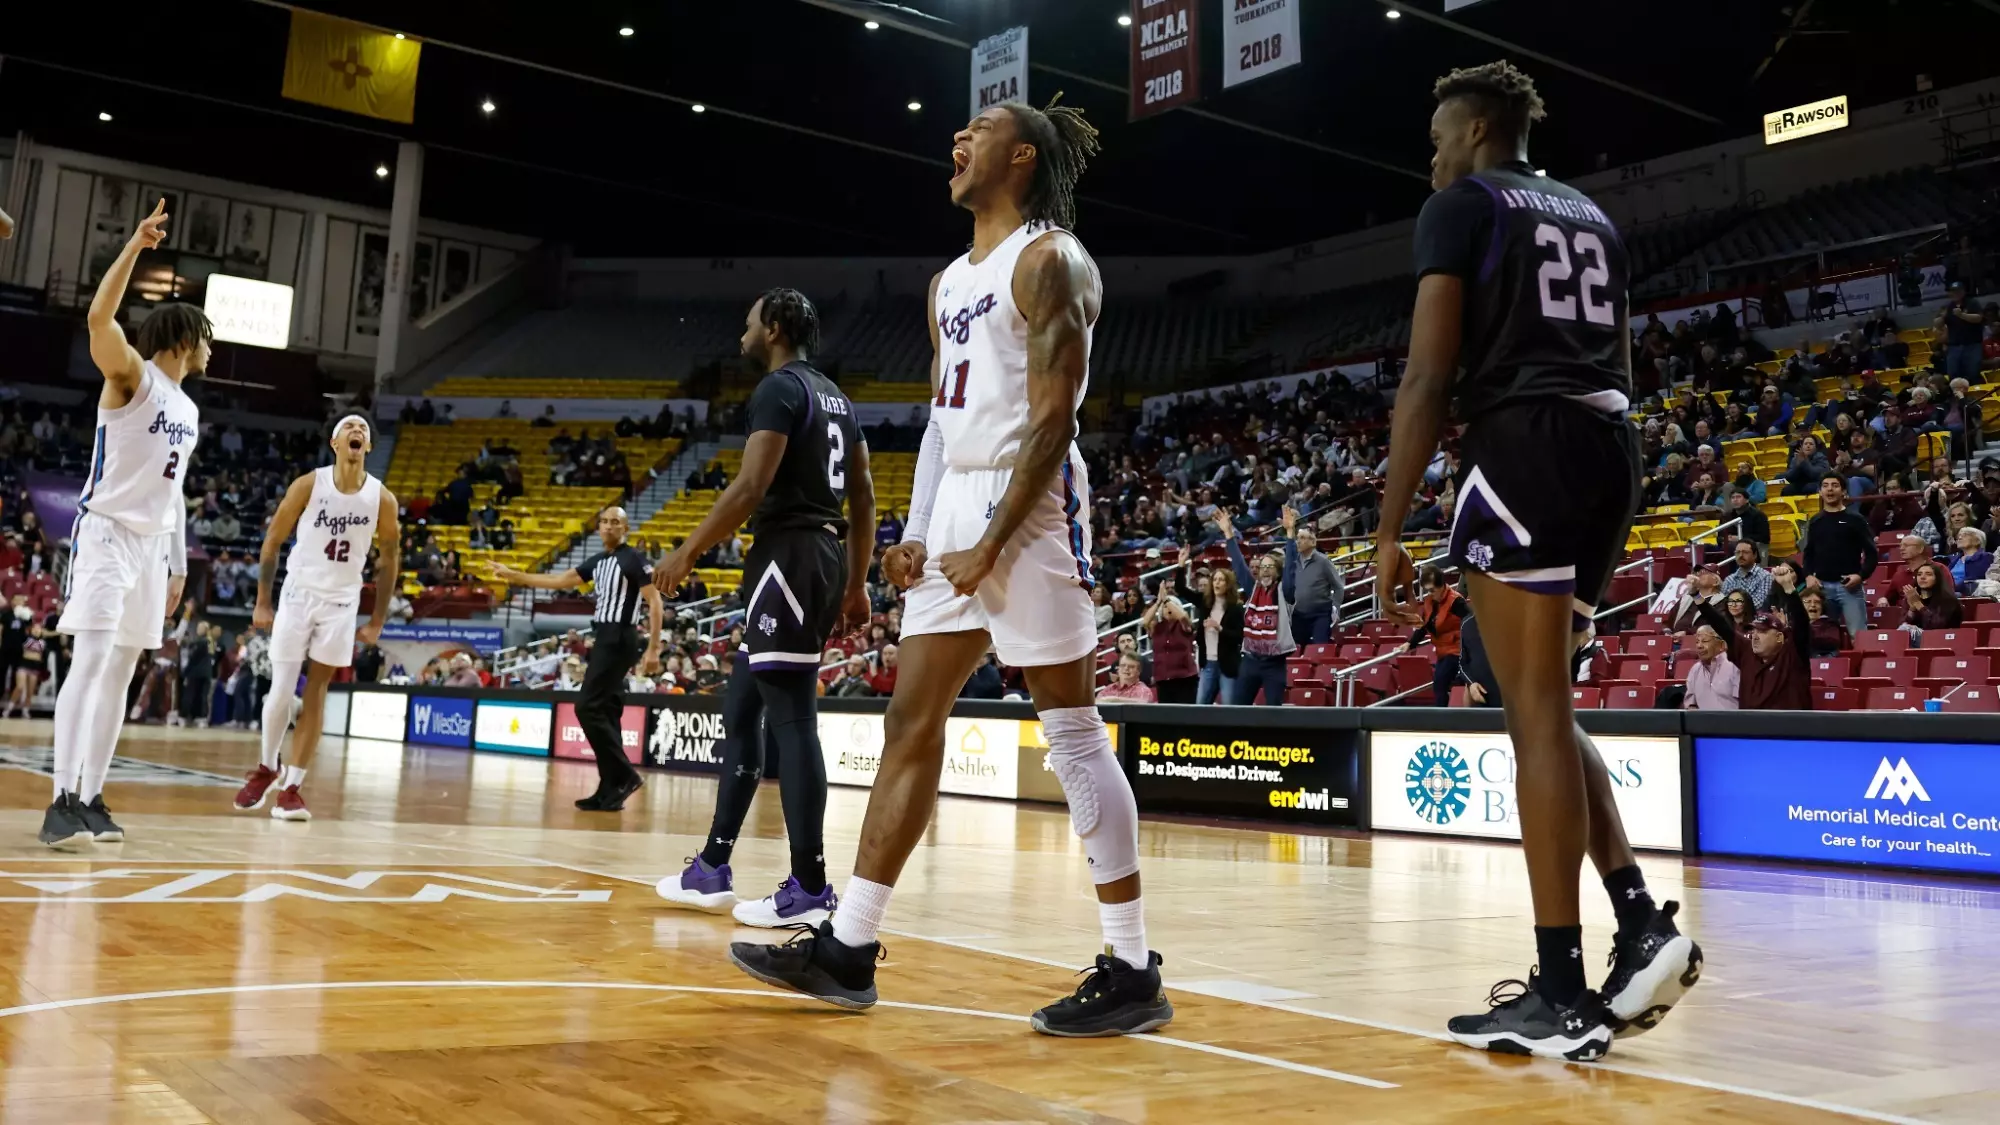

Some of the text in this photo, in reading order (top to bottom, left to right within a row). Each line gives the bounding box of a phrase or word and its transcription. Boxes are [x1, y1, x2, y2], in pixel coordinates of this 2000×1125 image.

[1235, 1, 1286, 25] TOURNAMENT
[1140, 9, 1188, 47] NCAA
[1141, 36, 1188, 61] TOURNAMENT
[1240, 33, 1281, 71] 2018
[979, 76, 1018, 109] NCAA
[1144, 70, 1182, 104] 2018
[1782, 103, 1845, 128] RAWSON
[1904, 95, 1938, 114] 210
[1620, 164, 1645, 181] 211
[1535, 223, 1615, 326] 22
[215, 291, 282, 316] WHITE
[817, 391, 847, 415] WARE
[148, 410, 195, 446] Aggies
[162, 450, 179, 480] 2
[827, 421, 845, 490] 2
[314, 508, 370, 536] Aggies
[324, 538, 350, 562] 42
[676, 712, 726, 739] PIONE
[1139, 737, 1315, 767] Be a Game Changer.
[946, 756, 999, 778] Ashley
[1138, 760, 1283, 782] Be a Designated Driver.
[1269, 787, 1329, 810] endwi
[1482, 789, 1519, 823] BA
[1788, 804, 1869, 824] Memorial
[1874, 809, 1946, 829] Medical
[1821, 833, 1856, 847] Care
[1860, 835, 1882, 848] for
[1886, 839, 1921, 853] your
